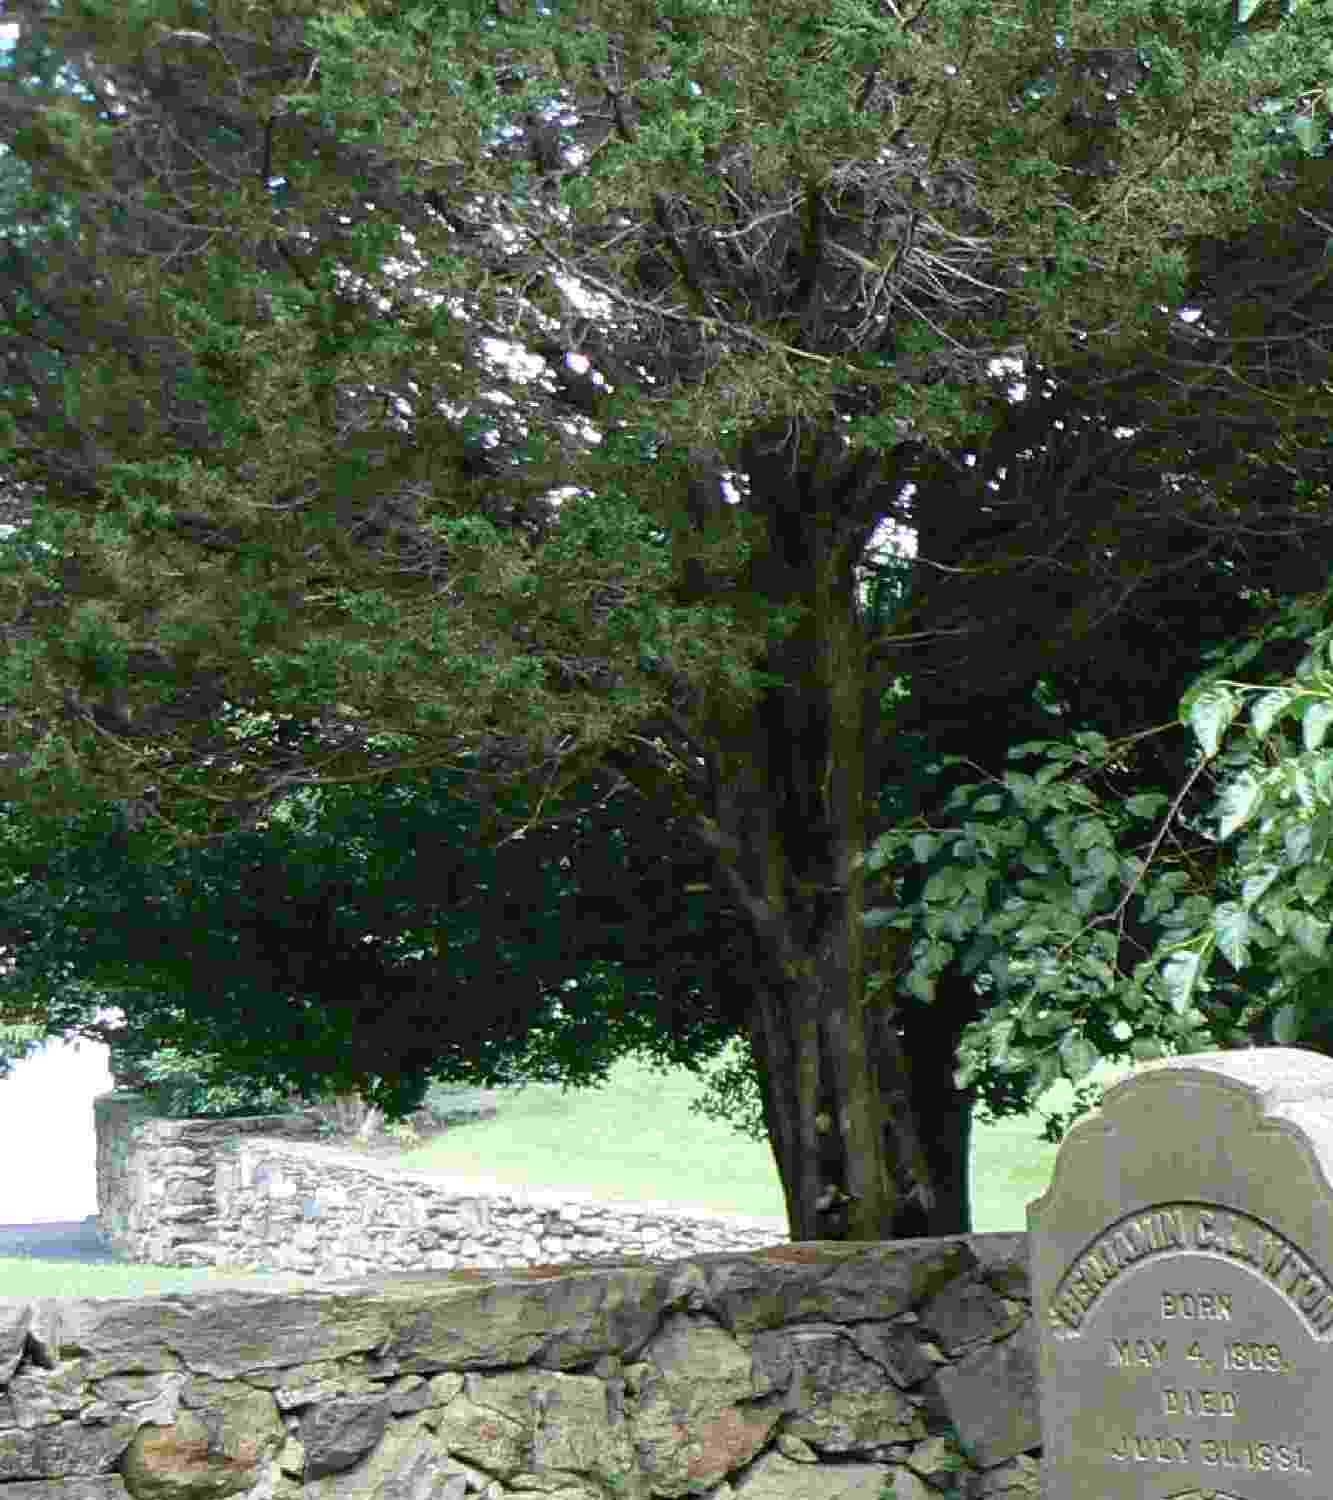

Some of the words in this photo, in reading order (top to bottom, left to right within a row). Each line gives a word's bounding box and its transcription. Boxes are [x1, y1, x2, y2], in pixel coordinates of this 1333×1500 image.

[1160, 1289, 1233, 1321] BORN
[1104, 1337, 1168, 1369] MAY
[1160, 1386, 1240, 1418] DIED
[1110, 1433, 1194, 1465] JULY
